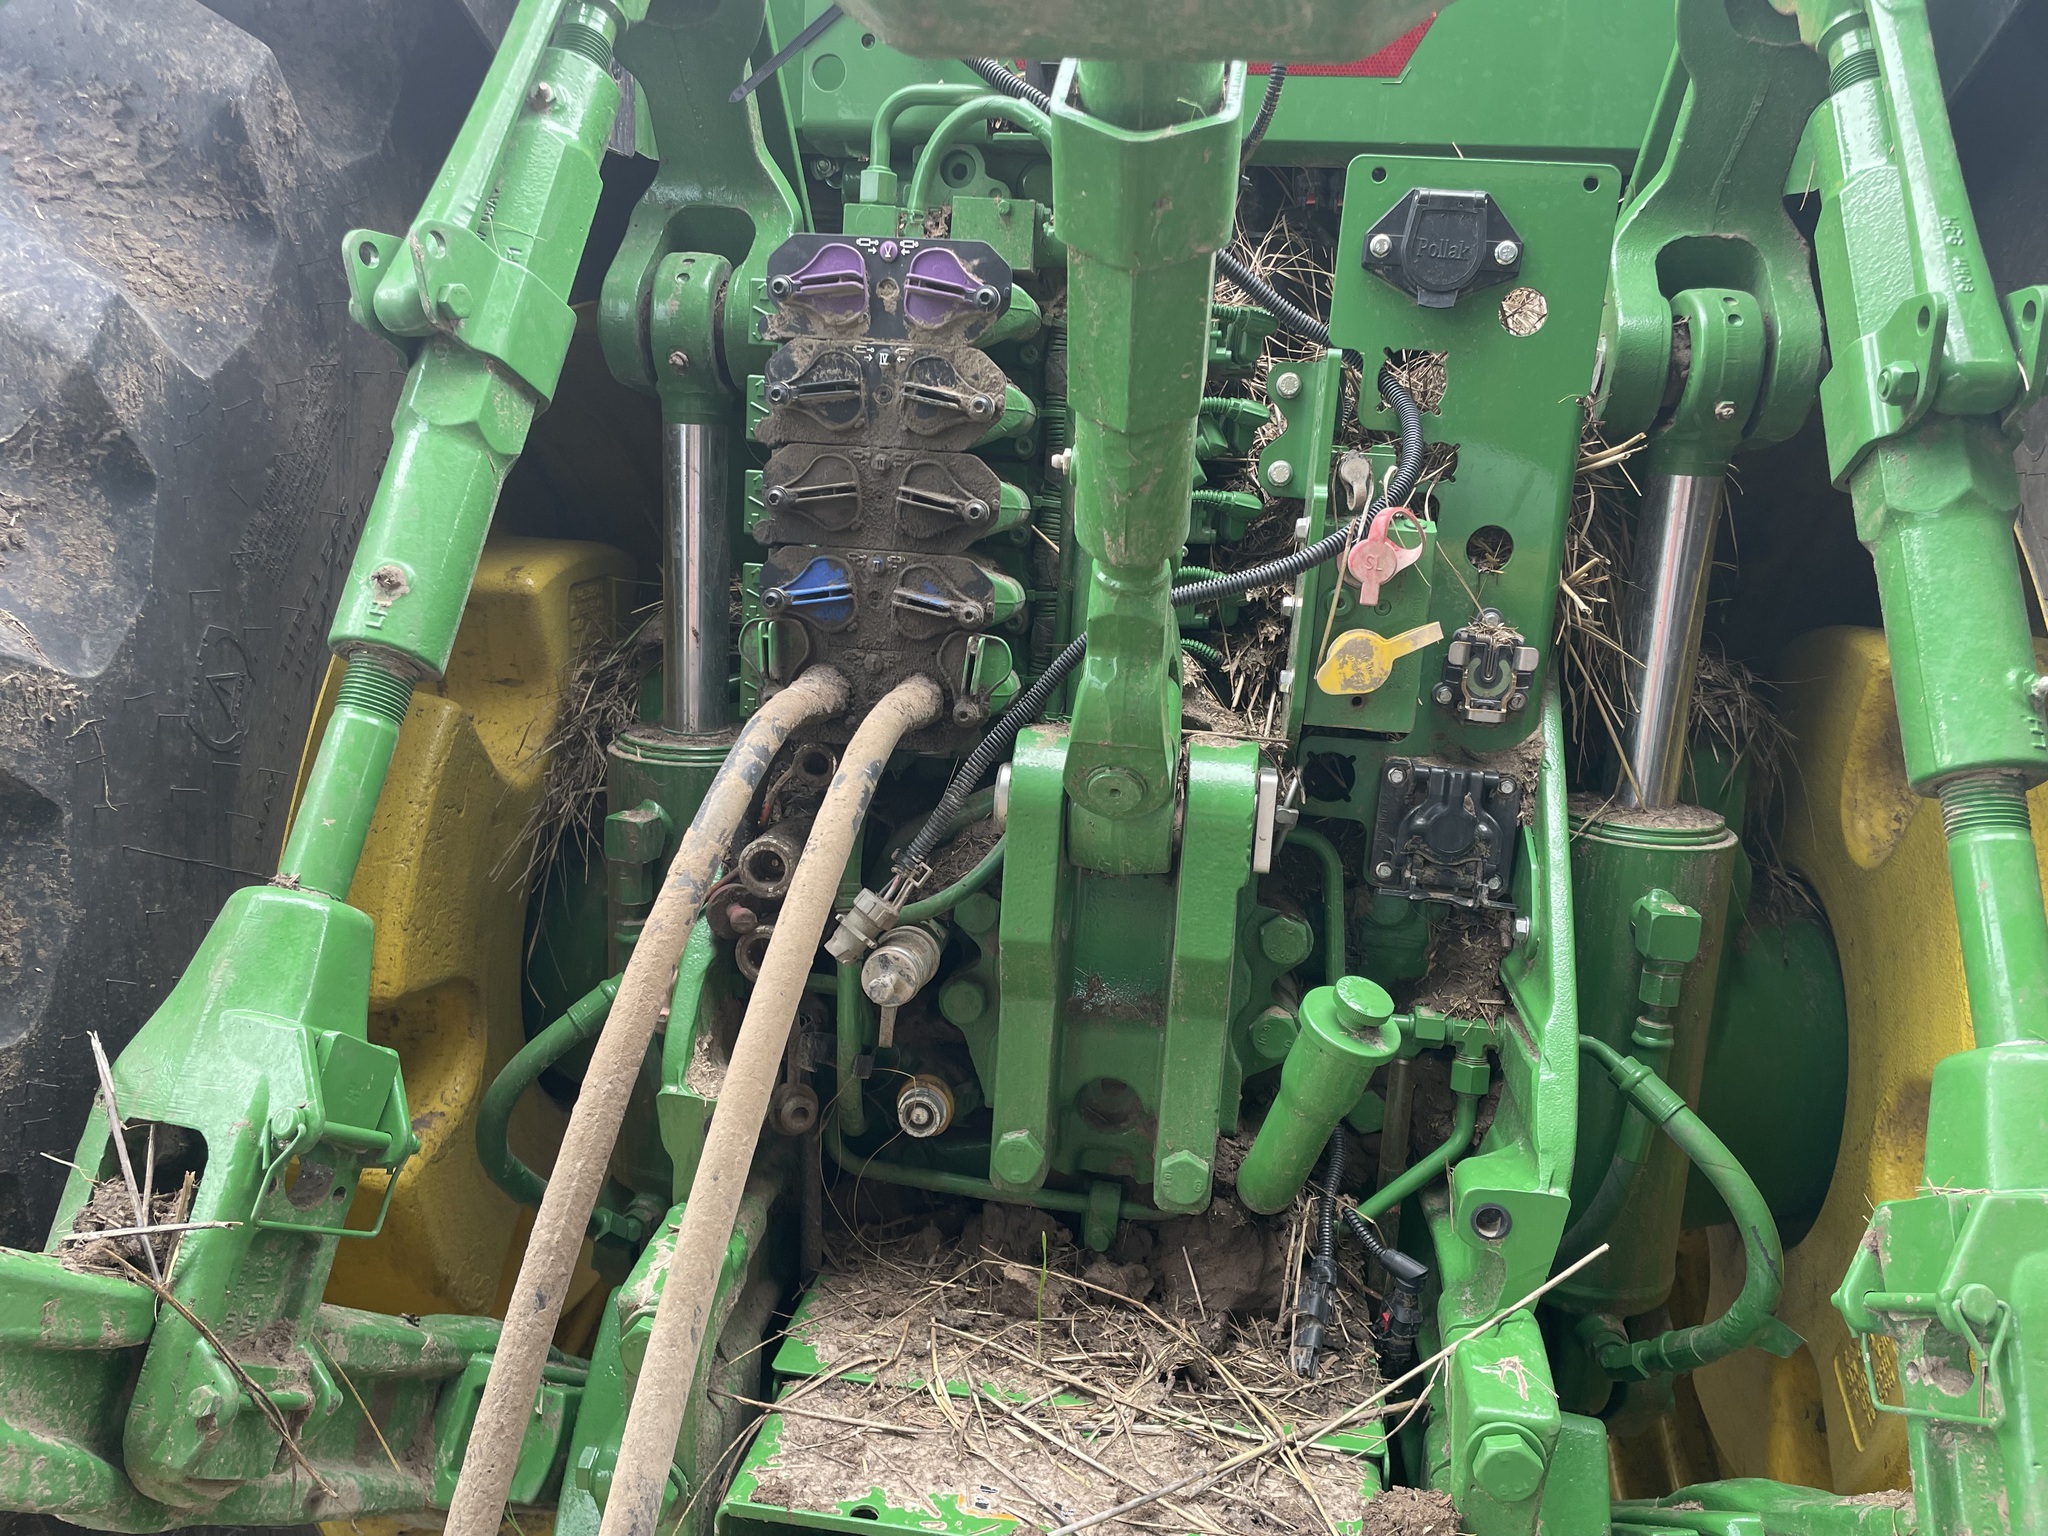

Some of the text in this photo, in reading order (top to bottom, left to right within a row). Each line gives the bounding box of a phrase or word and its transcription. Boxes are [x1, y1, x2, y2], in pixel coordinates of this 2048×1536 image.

[1416, 236, 1471, 260] Pollak
[879, 352, 890, 366] IV
[1365, 554, 1383, 571] SL
